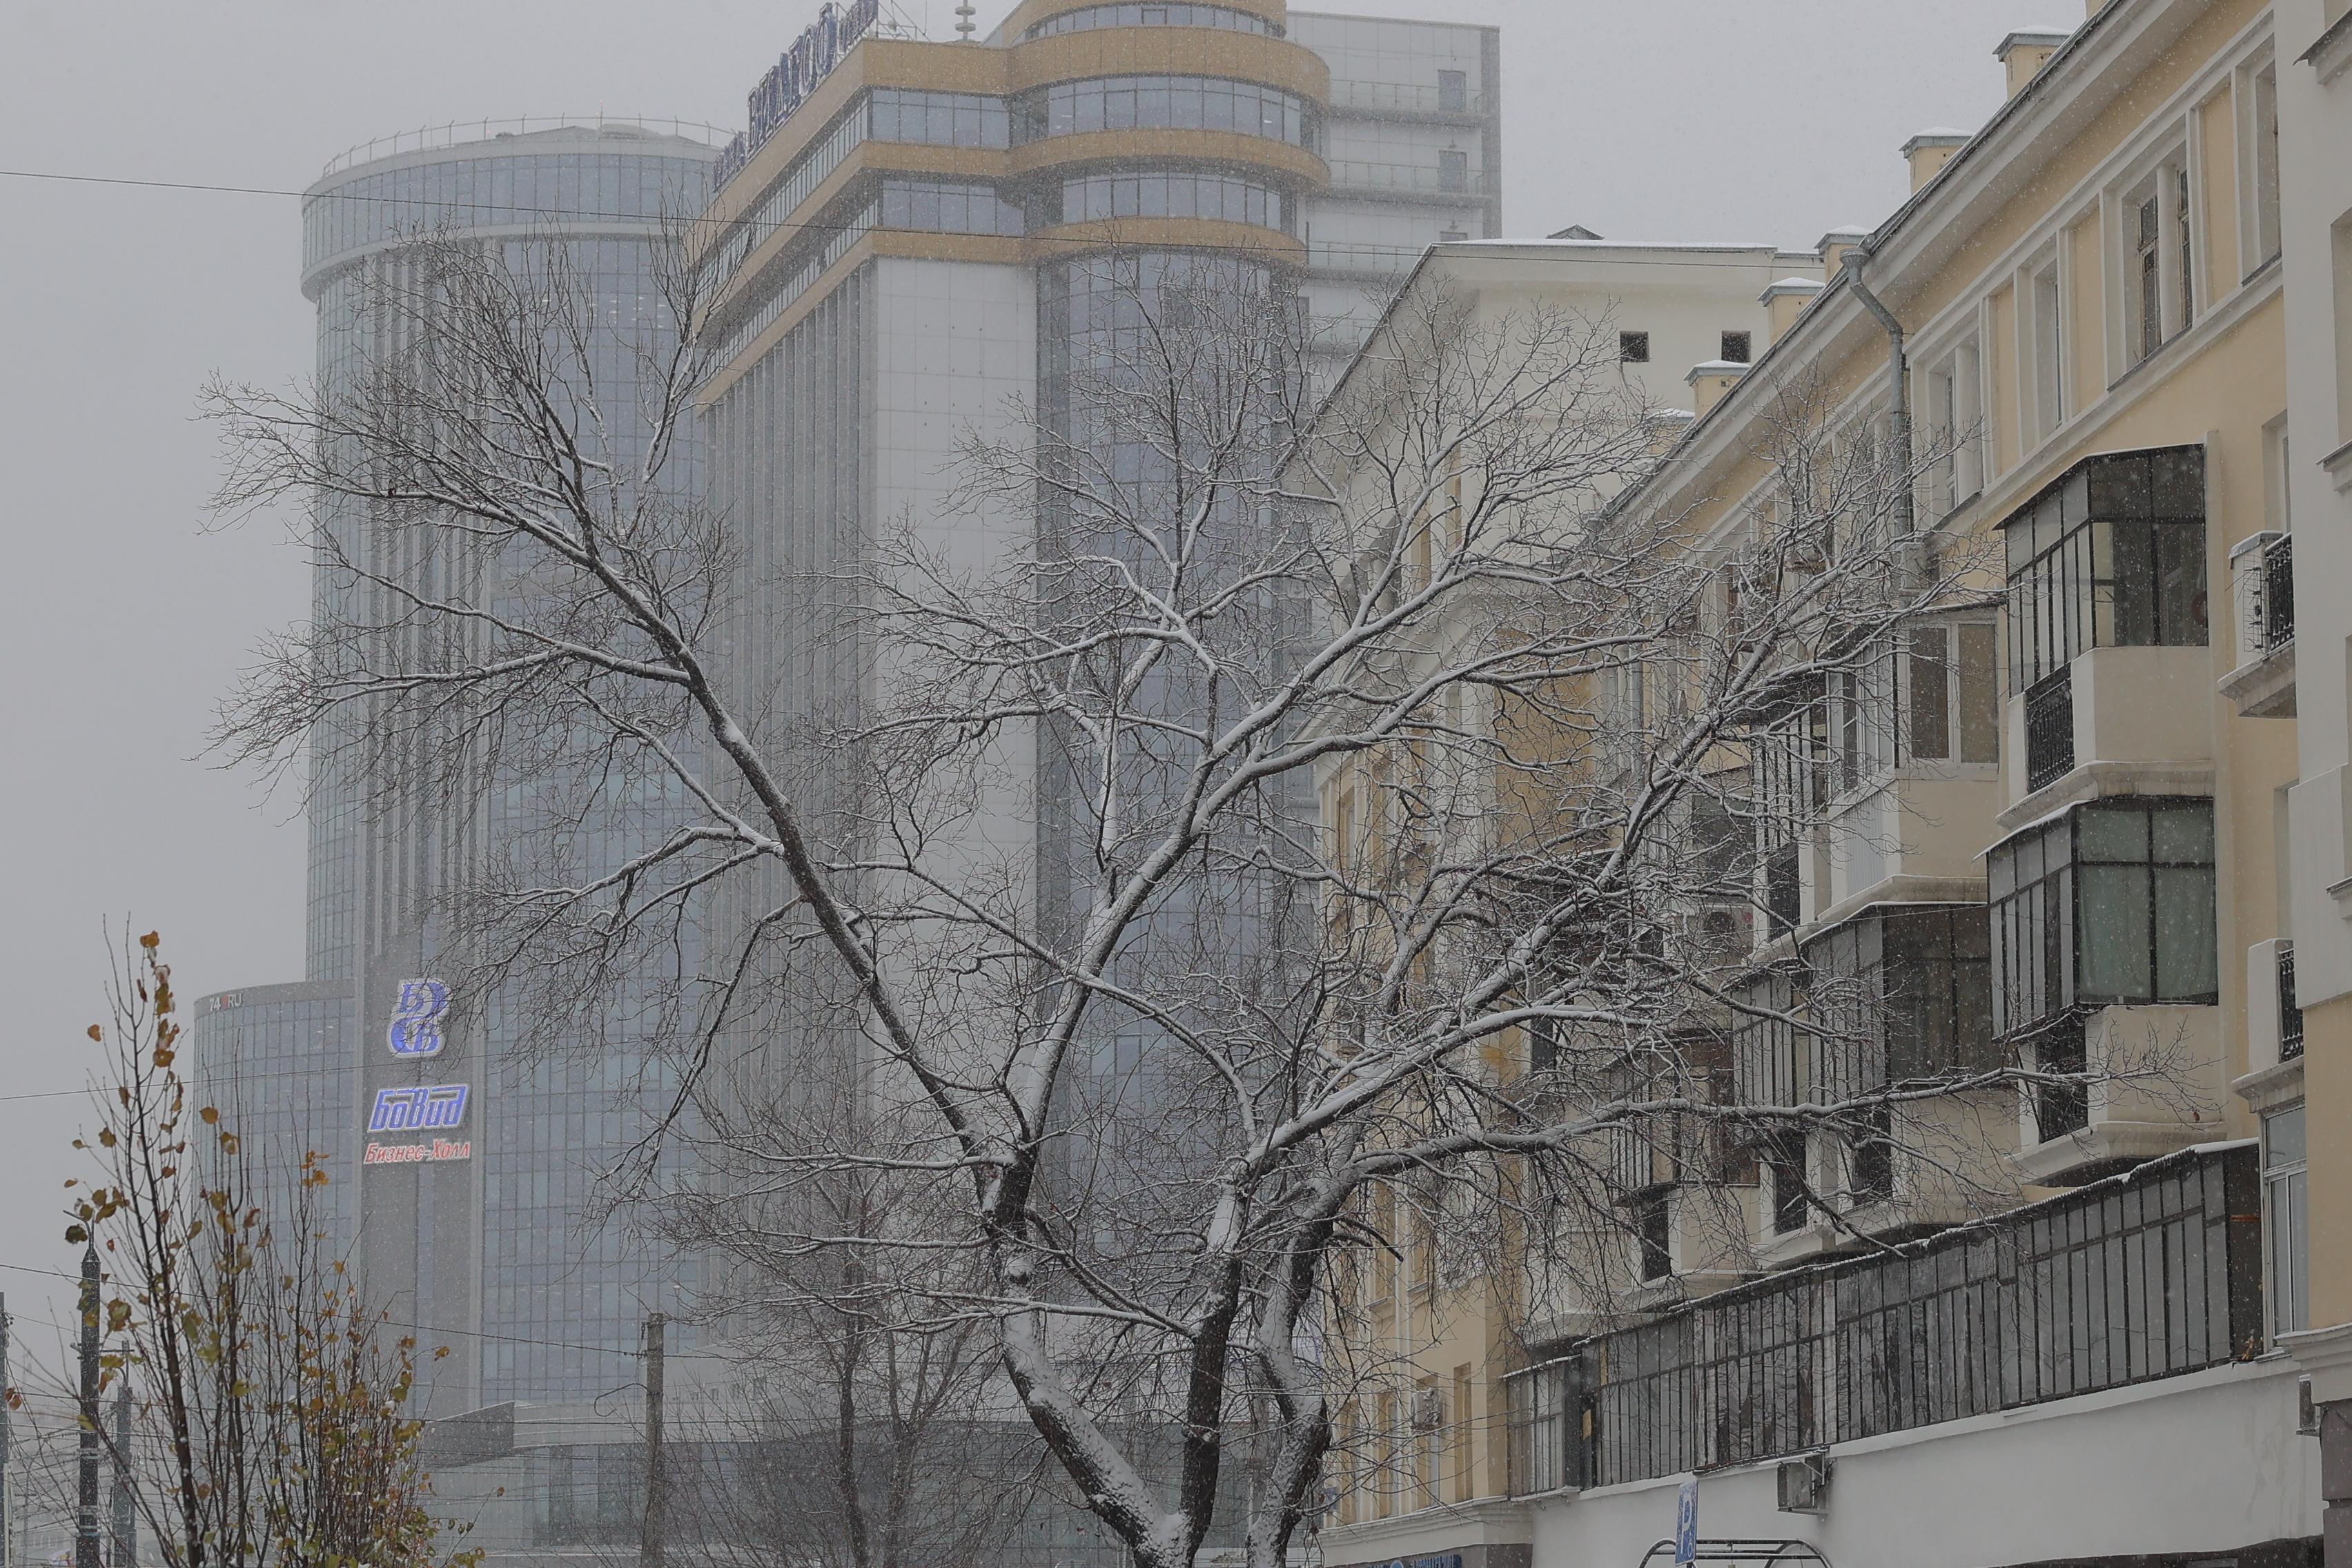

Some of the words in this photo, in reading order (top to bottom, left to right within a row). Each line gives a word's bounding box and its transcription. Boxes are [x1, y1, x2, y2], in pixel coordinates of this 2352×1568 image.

[747, 2, 836, 159] ВИДГОФ
[364, 1139, 471, 1164] Бизнес-Холл
[1680, 1492, 1692, 1554] P
